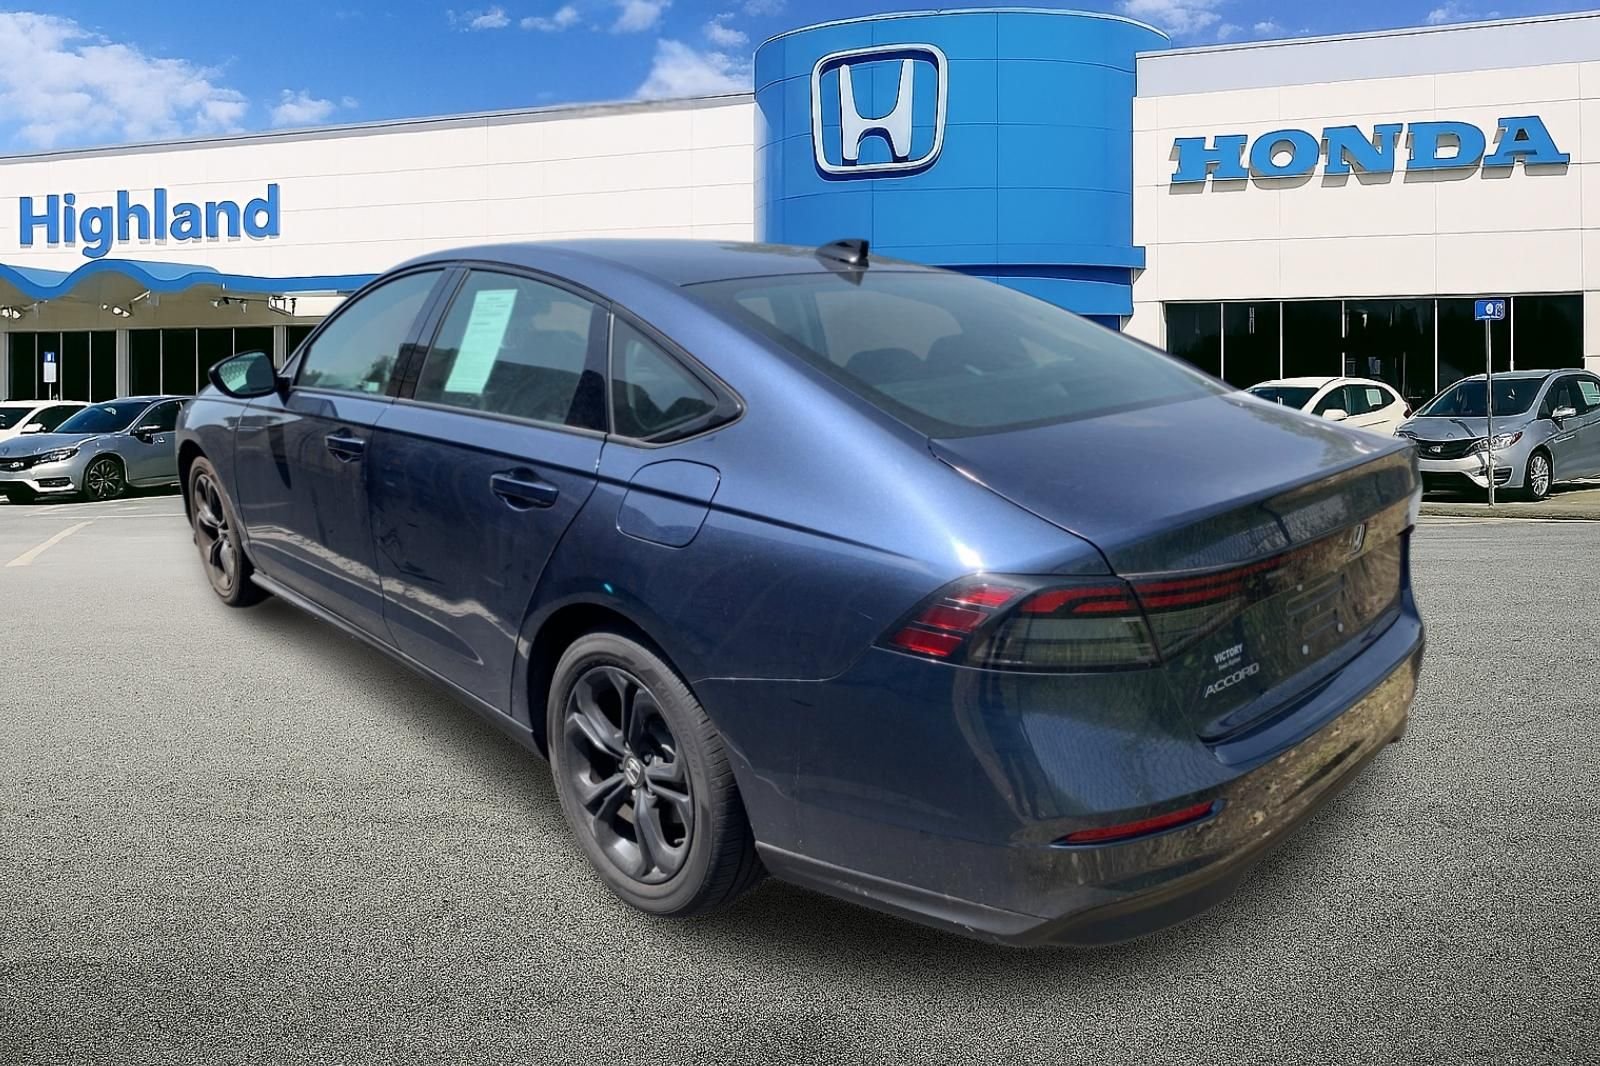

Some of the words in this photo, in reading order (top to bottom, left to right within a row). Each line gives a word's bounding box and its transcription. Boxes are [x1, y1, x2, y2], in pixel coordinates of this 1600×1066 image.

[1170, 115, 1570, 184] HONDA
[19, 183, 280, 258] Highland
[1213, 643, 1243, 664] VICTORY
[1204, 662, 1260, 698] ACCORD
